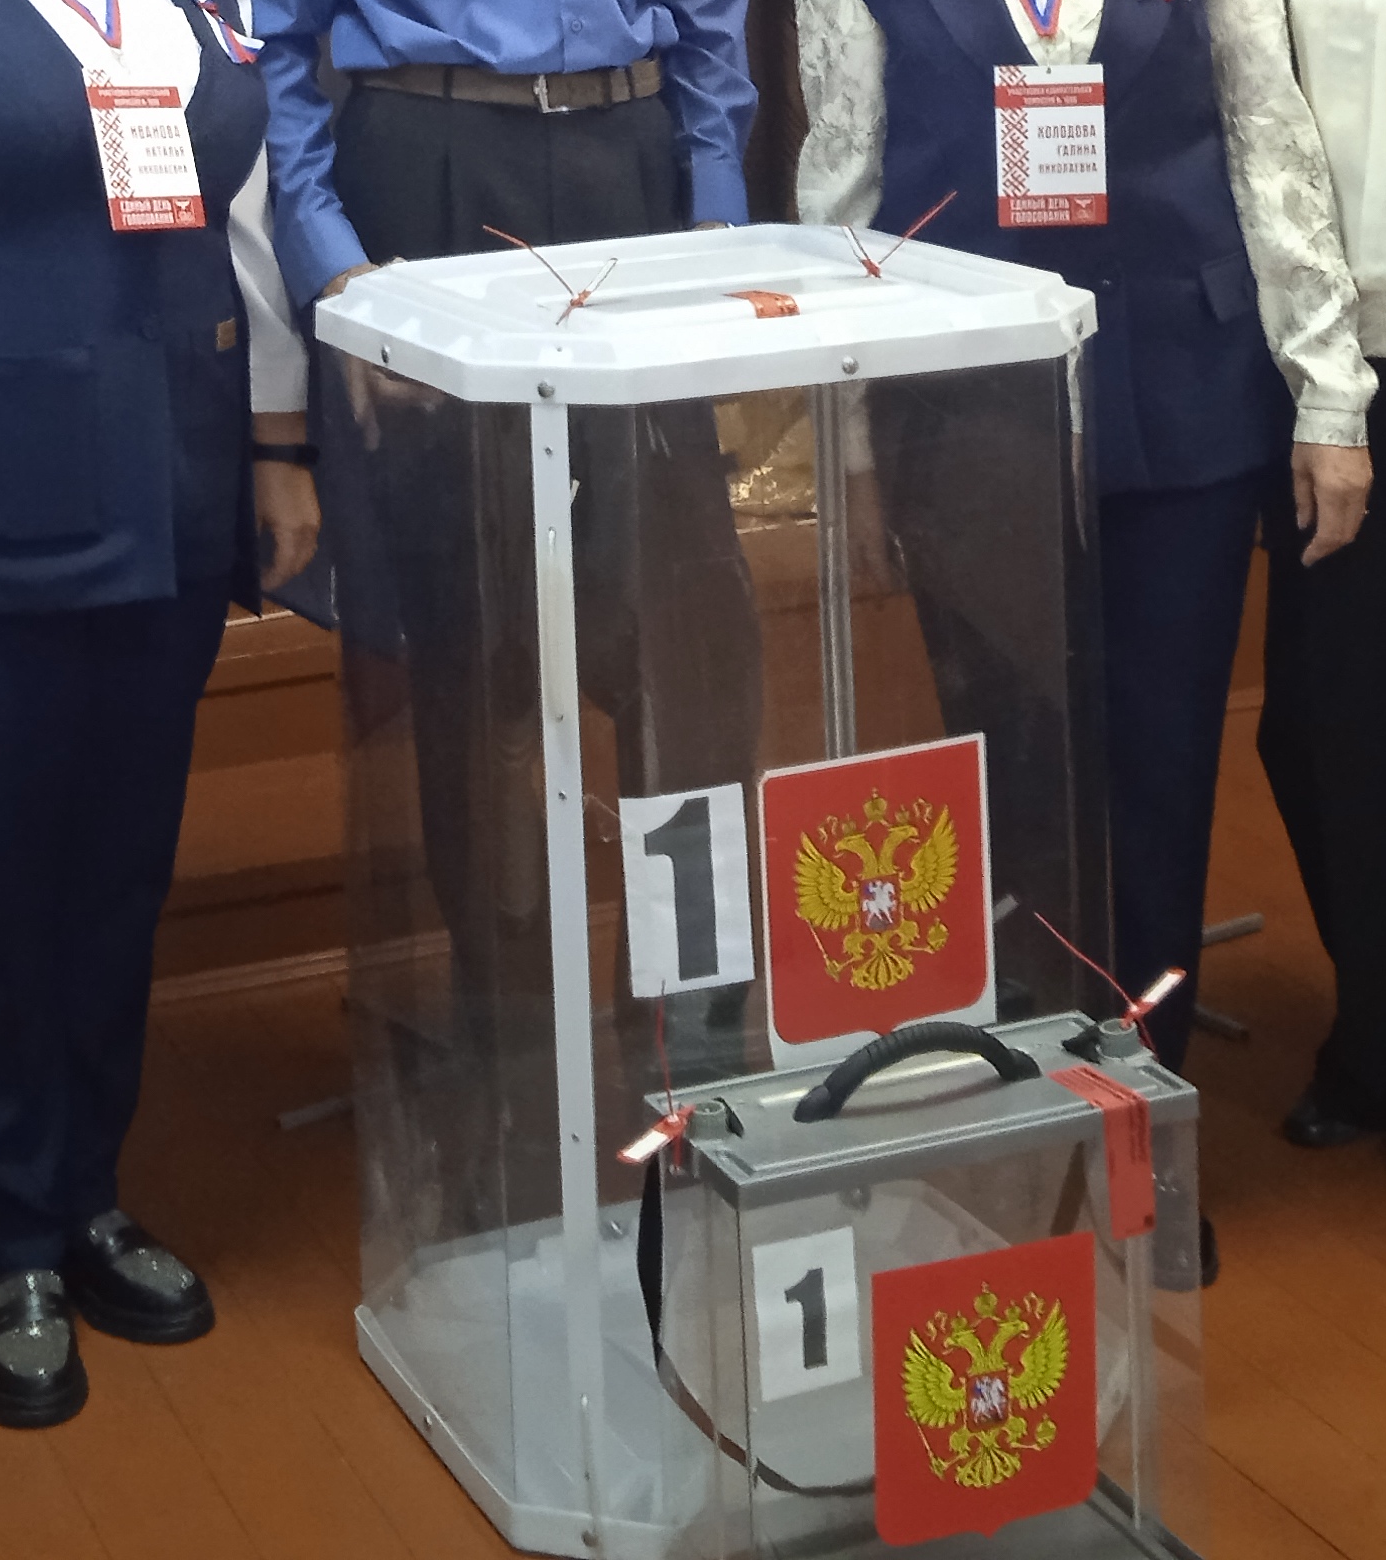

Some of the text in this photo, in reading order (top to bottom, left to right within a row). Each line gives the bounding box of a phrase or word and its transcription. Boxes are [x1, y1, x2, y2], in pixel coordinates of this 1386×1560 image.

[145, 146, 185, 157] НАТАЛЬЯ
[1057, 144, 1097, 157] ГАЛИНА
[1038, 162, 1098, 174] НИКОЛАЕВНА
[643, 796, 719, 982] 1
[784, 1267, 828, 1371] 1
